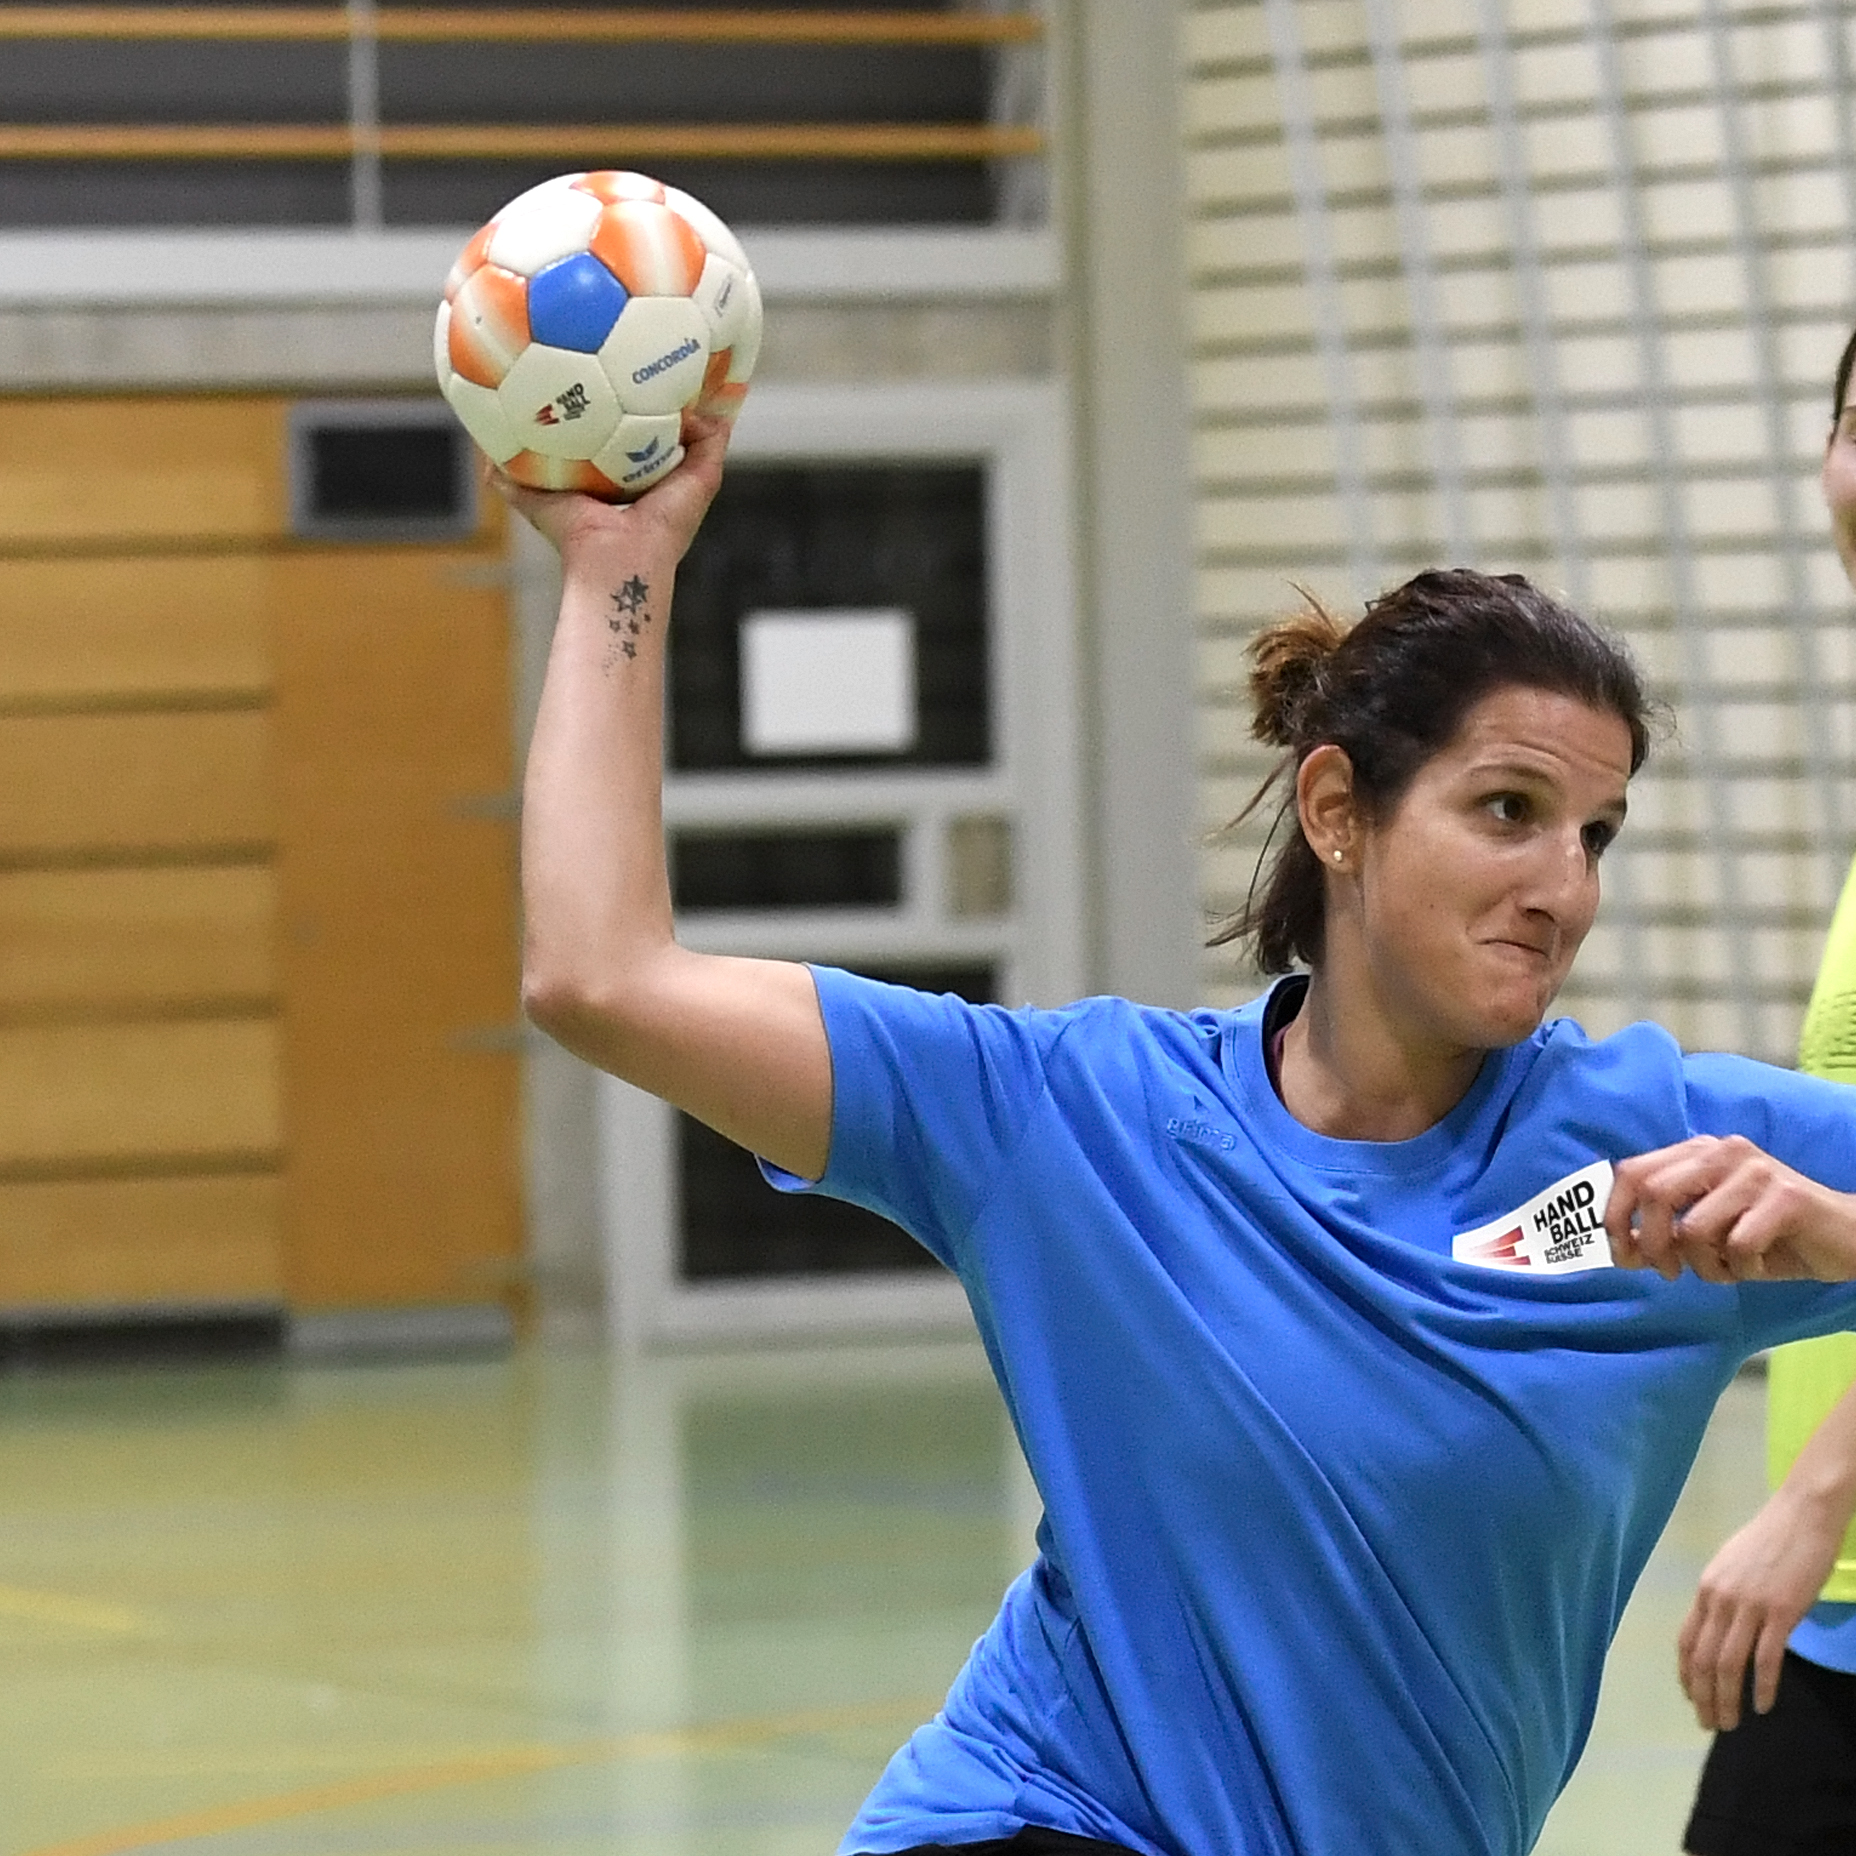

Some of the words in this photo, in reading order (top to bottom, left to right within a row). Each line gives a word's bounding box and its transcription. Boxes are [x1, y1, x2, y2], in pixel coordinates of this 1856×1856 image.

[632, 337, 701, 385] CONCORDIA
[1533, 1180, 1595, 1233] HAND
[1550, 1206, 1605, 1244] BALL
